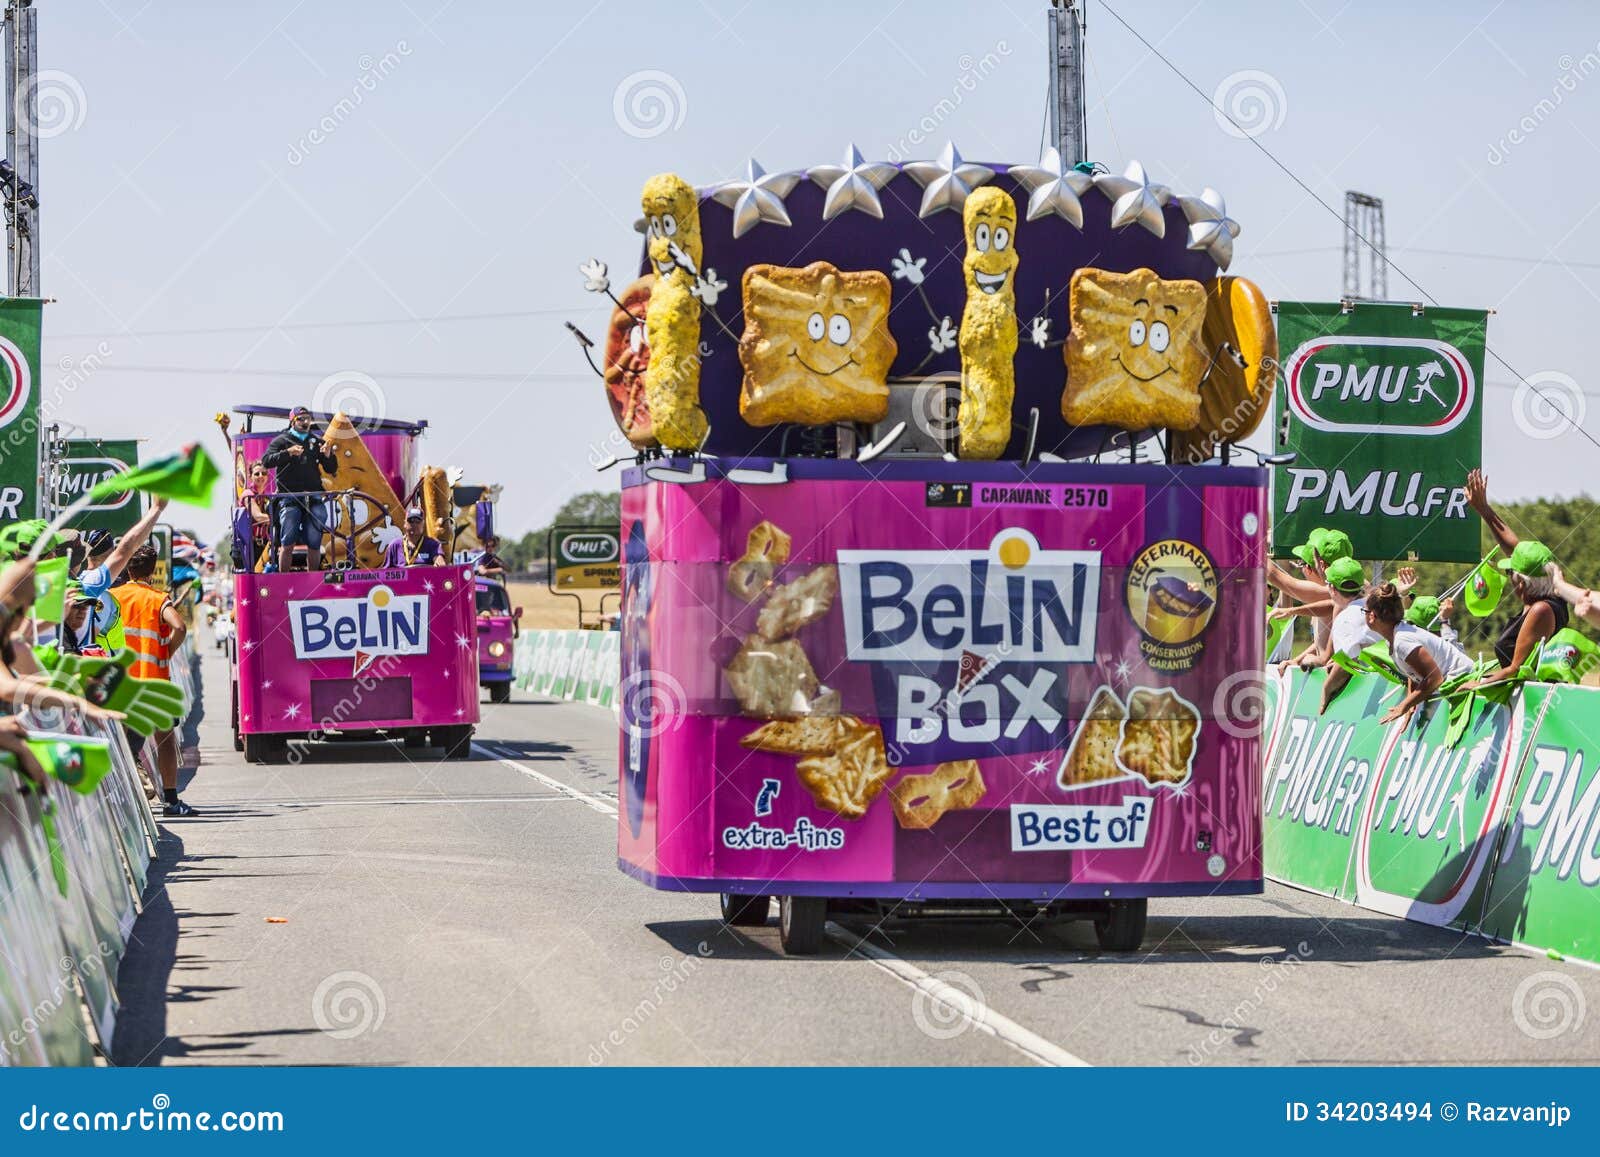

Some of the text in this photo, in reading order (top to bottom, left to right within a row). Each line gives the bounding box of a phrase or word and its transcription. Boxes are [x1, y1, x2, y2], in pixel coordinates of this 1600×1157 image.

[1311, 363, 1410, 402] PMU
[981, 487, 1109, 507] CARAVANE 2570
[1285, 467, 1468, 519] PMU.FR
[569, 541, 599, 553] PMU
[1130, 543, 1216, 588] REFERMABLE
[1140, 640, 1203, 658] CONSERVATION
[896, 667, 1062, 743] BOX
[1265, 716, 1370, 836] PMU.FR
[1374, 740, 1467, 839] PMU
[724, 818, 843, 850] extra-fins
[1018, 802, 1146, 846] Best of
